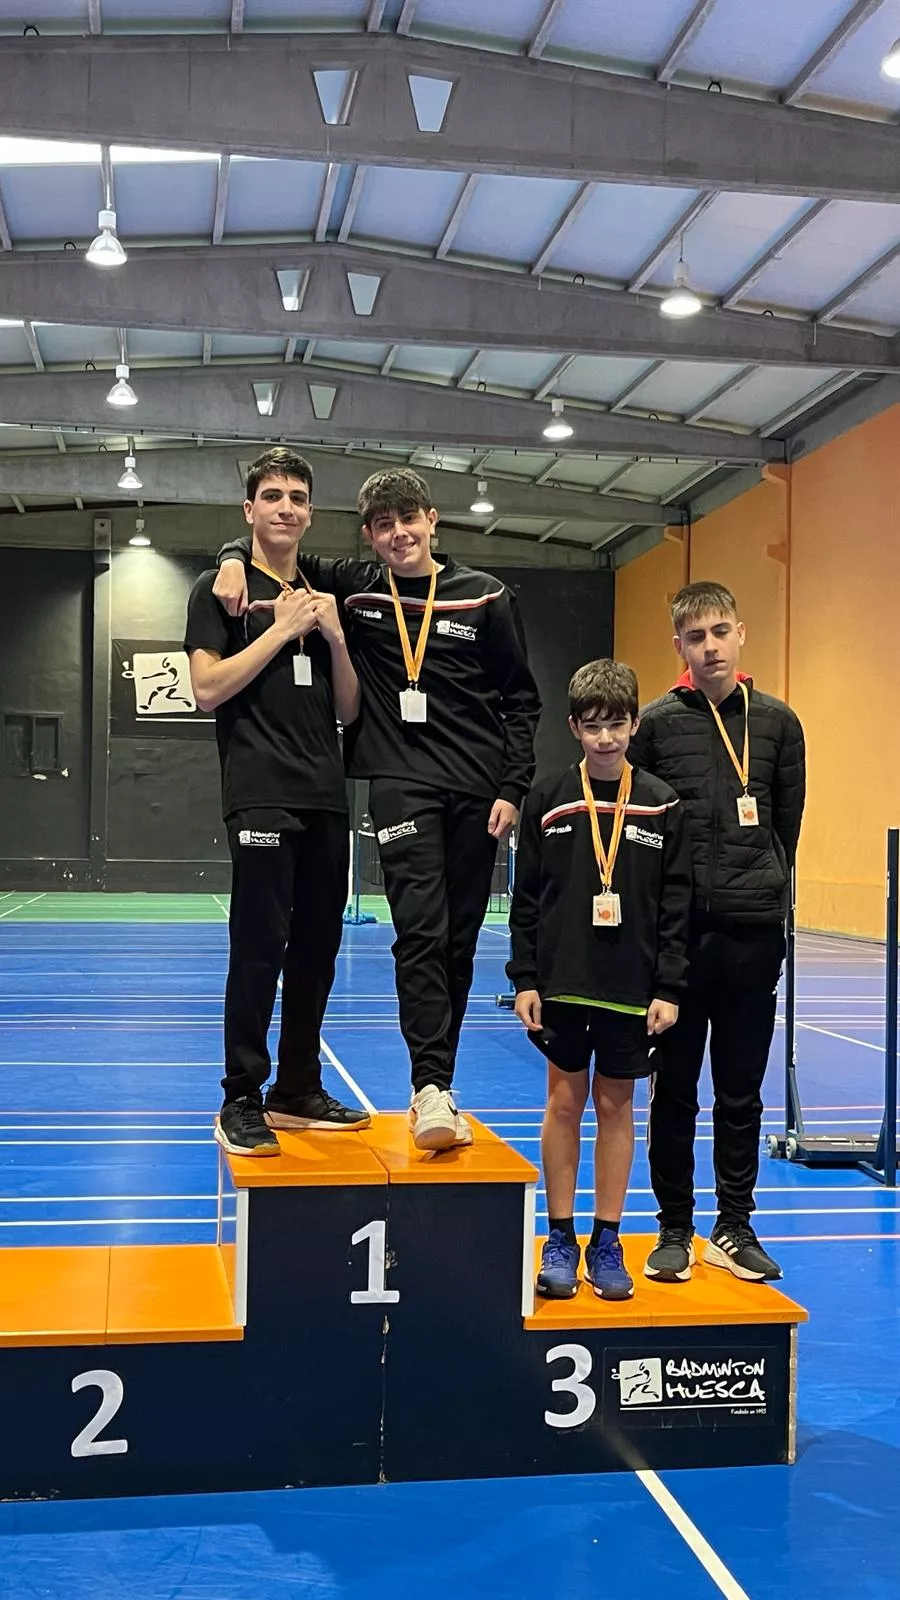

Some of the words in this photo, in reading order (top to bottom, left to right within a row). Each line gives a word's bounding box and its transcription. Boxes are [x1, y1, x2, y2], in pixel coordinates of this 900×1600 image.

[350, 1220, 399, 1304] 1
[70, 1369, 128, 1457] 2
[544, 1344, 597, 1428] 3
[665, 1379, 766, 1401] HUESCA
